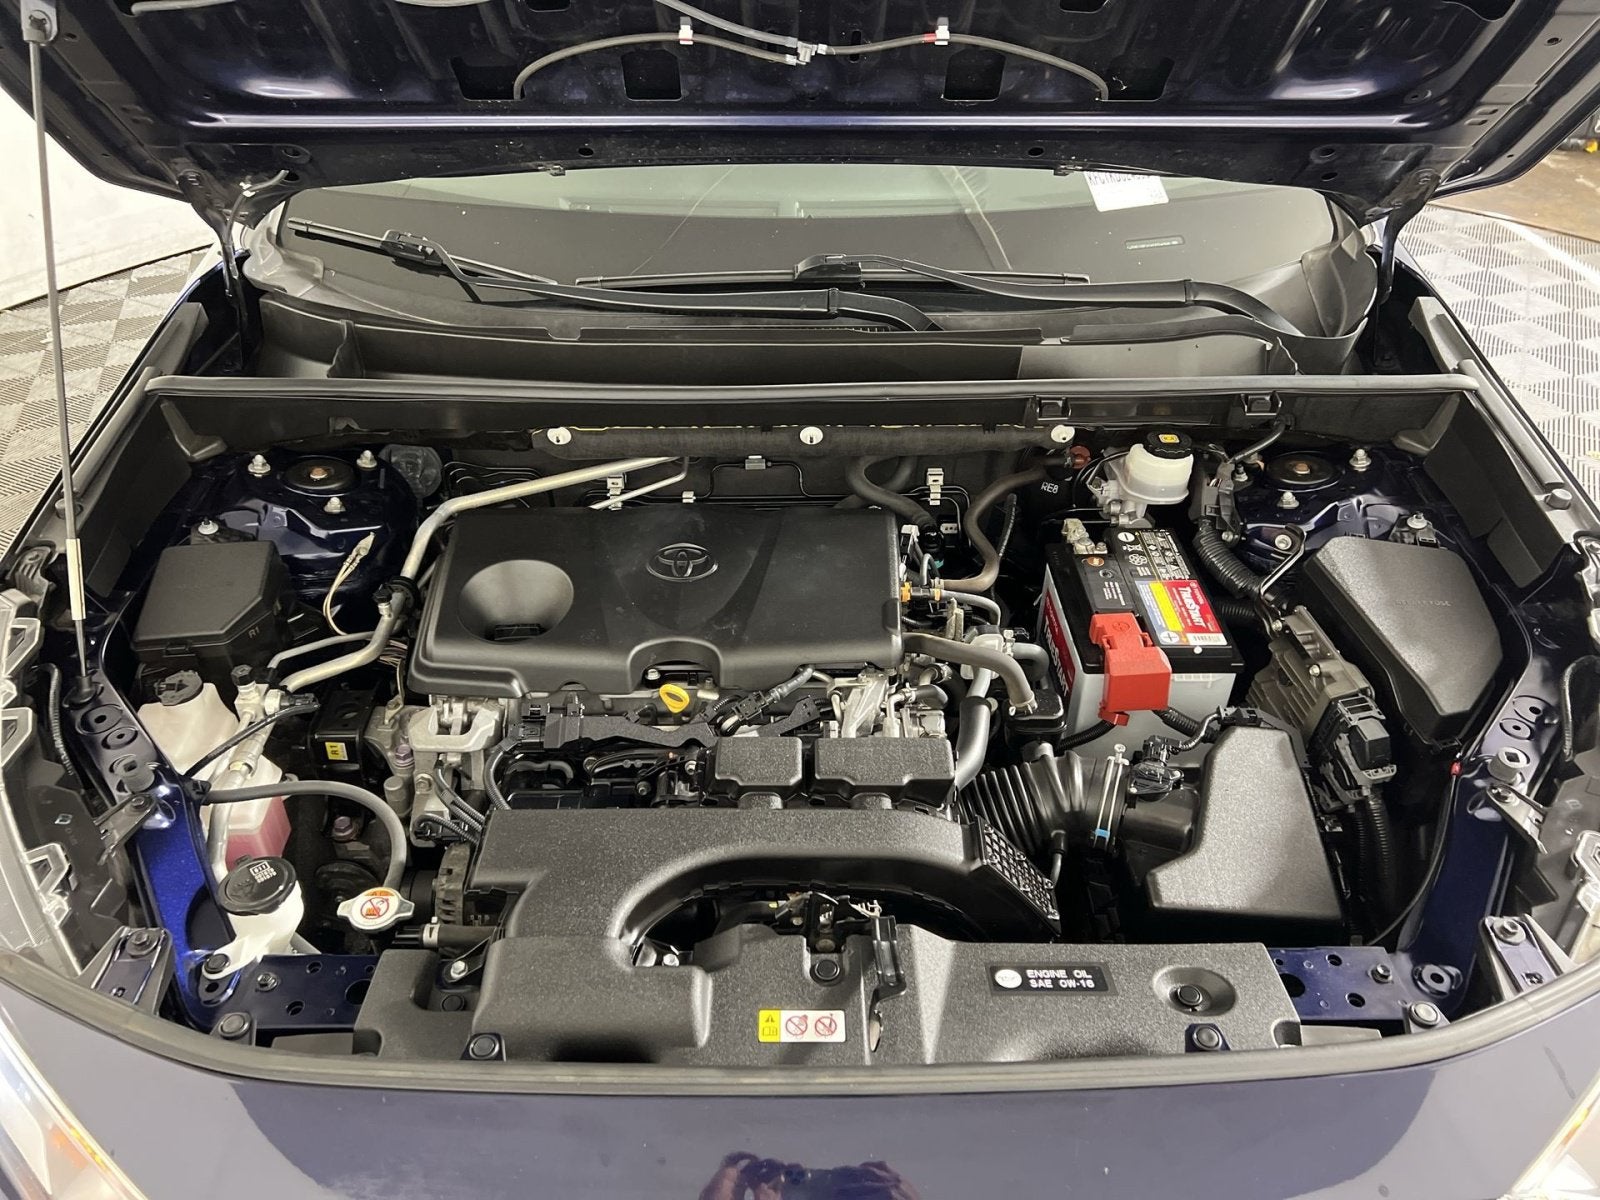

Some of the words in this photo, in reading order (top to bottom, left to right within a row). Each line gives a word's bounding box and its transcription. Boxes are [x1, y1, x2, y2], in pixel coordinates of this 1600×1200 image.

[1040, 481, 1059, 494] RE8
[1025, 969, 1068, 979] ENGINE
[1072, 969, 1093, 979] OIL
[1029, 979, 1054, 989] SAE
